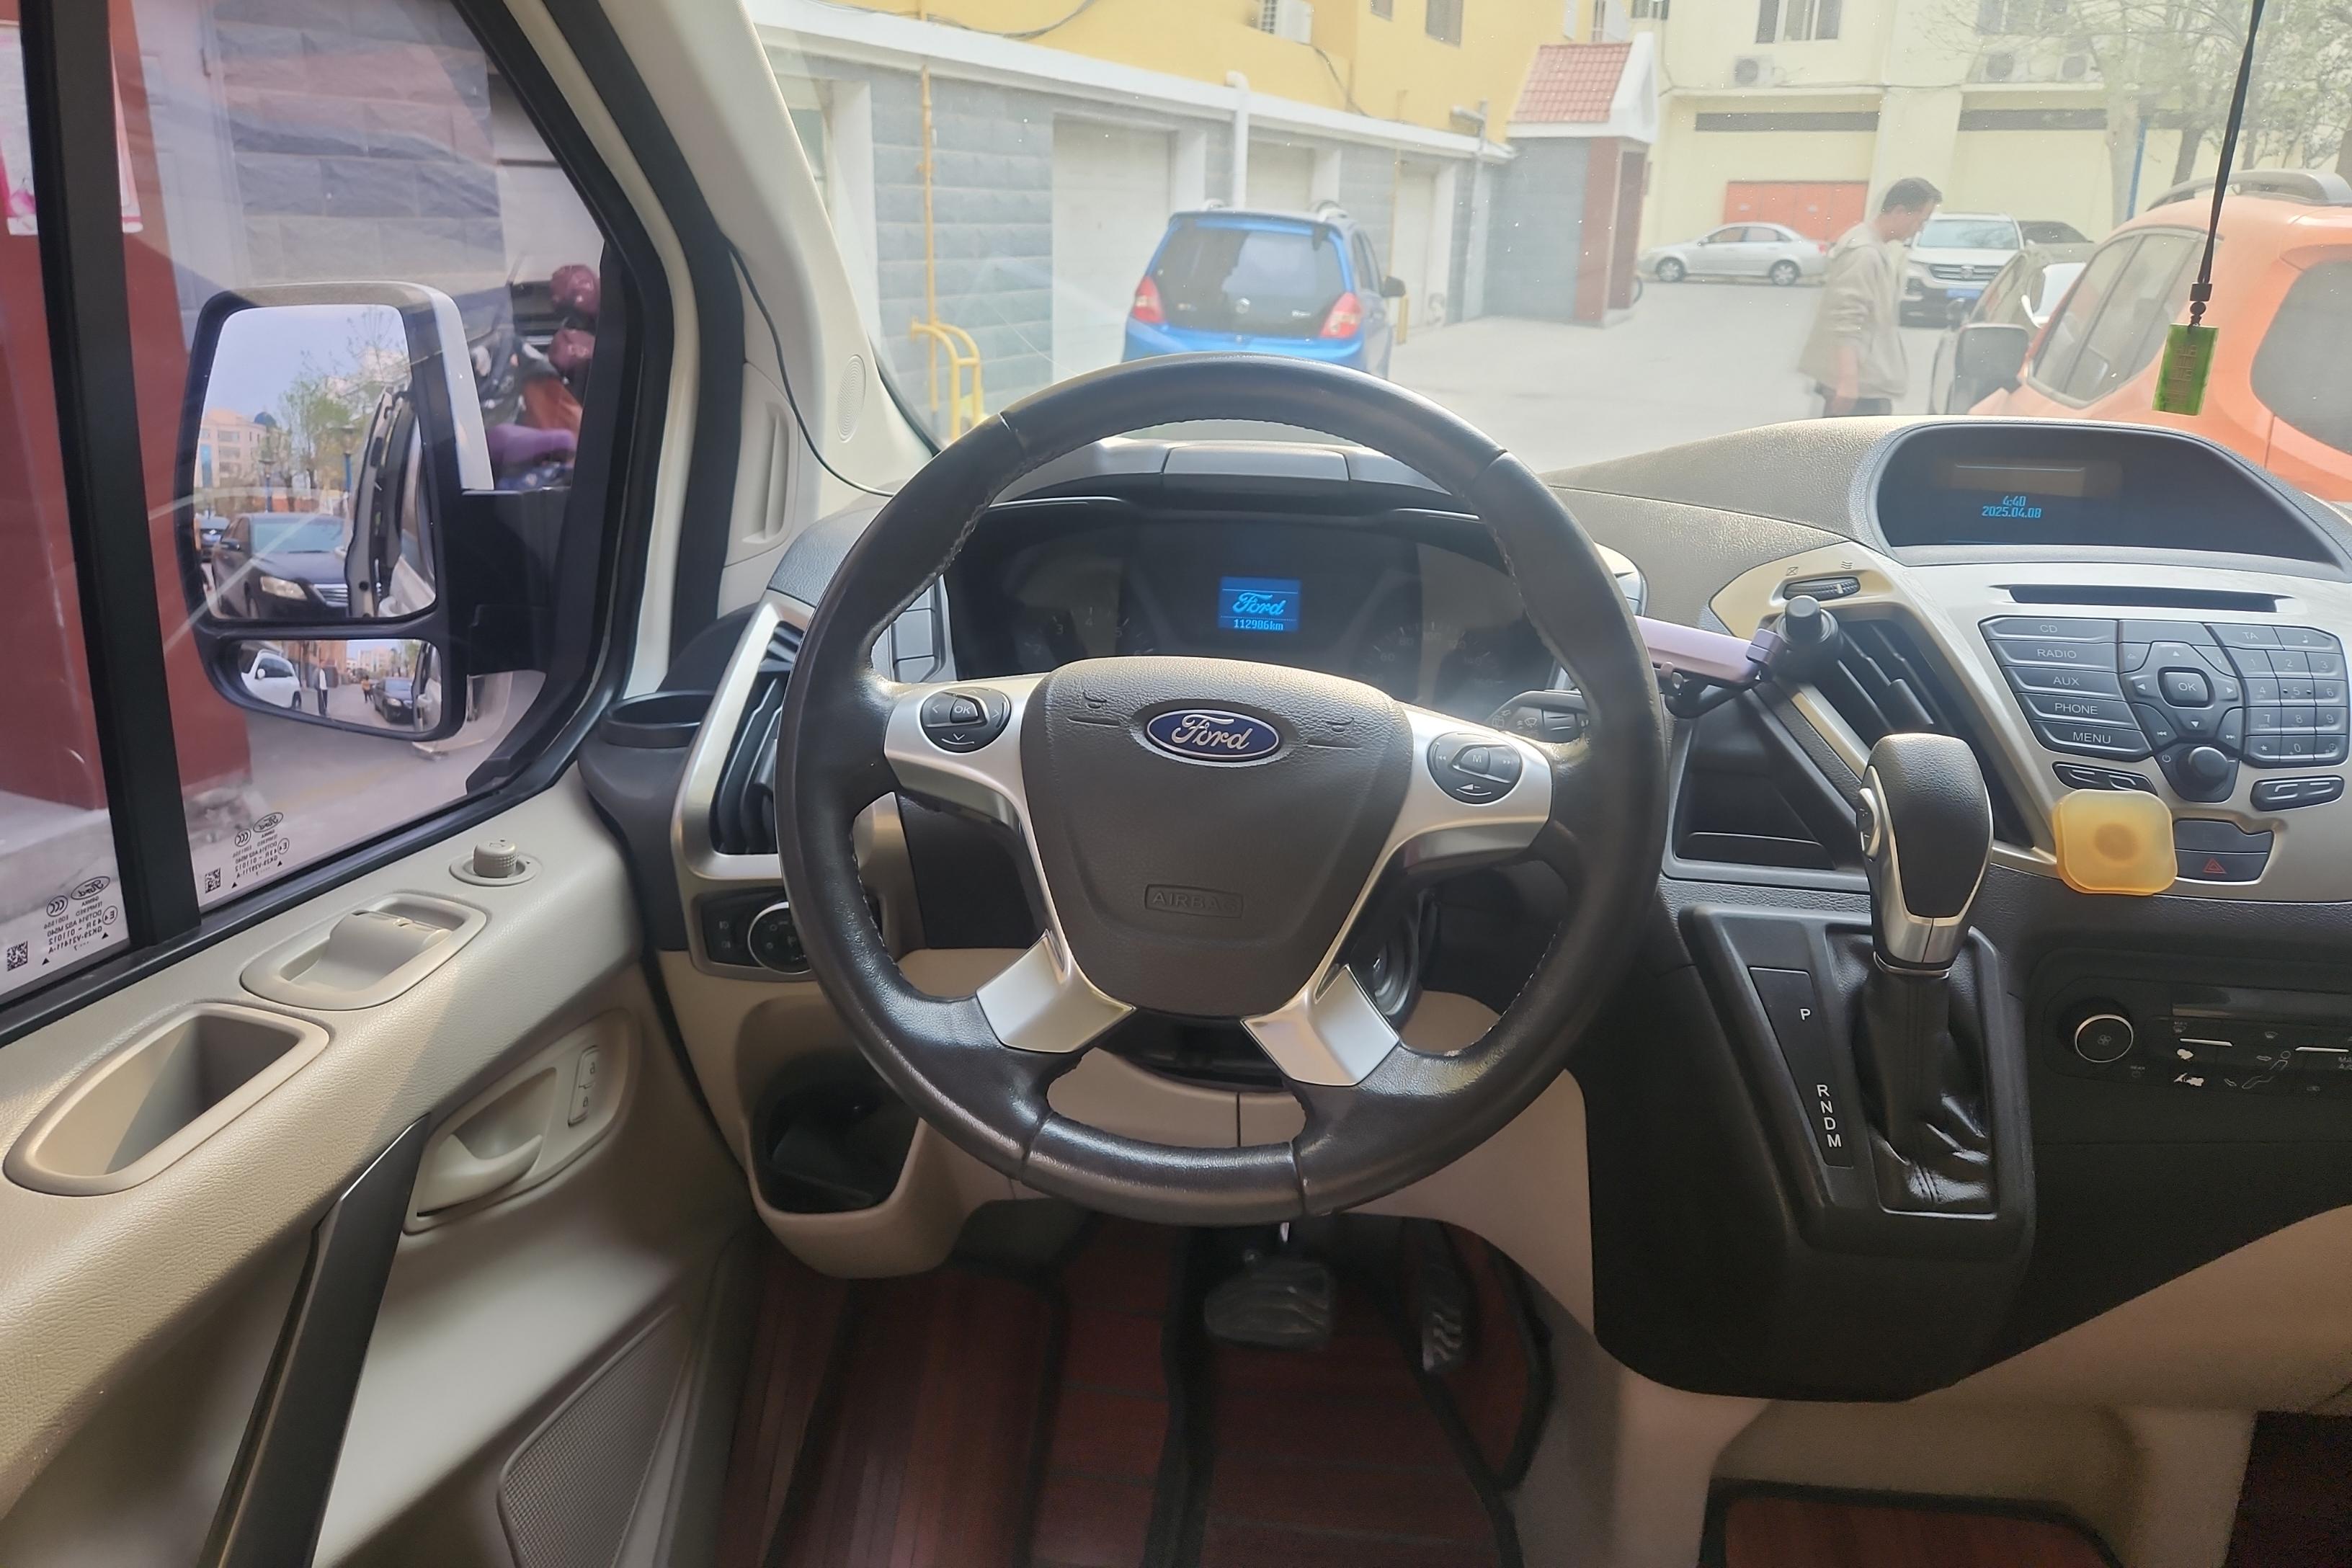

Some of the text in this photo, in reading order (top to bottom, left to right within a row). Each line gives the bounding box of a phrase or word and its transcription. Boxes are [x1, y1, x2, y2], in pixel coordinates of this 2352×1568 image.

[2003, 495, 2026, 507] 4:40
[1982, 506, 2041, 518] 2025.04.08
[1232, 592, 1286, 615] Ford
[2040, 624, 2058, 633] CD
[2242, 631, 2258, 640] TA
[2036, 649, 2077, 659] RADIO
[2285, 659, 2293, 667] 2
[2320, 660, 2328, 669] 3
[2053, 677, 2080, 686] AUX
[2178, 682, 2197, 691] OK
[2259, 686, 2266, 695] 4
[2292, 687, 2300, 695] 5
[2326, 688, 2334, 697] 6
[954, 705, 971, 714] OK
[2054, 703, 2098, 715] PHONE
[2263, 714, 2271, 723] 7
[2295, 715, 2303, 723] 8
[2326, 714, 2334, 723] 9
[1172, 714, 1253, 750] Ford
[2073, 731, 2111, 744] MENU
[1472, 754, 1482, 763] M
[1800, 1008, 1811, 1020] P
[1817, 1084, 1830, 1097] R
[1820, 1100, 1833, 1114] N
[1824, 1116, 1836, 1131] D
[1827, 1133, 1842, 1148] M
